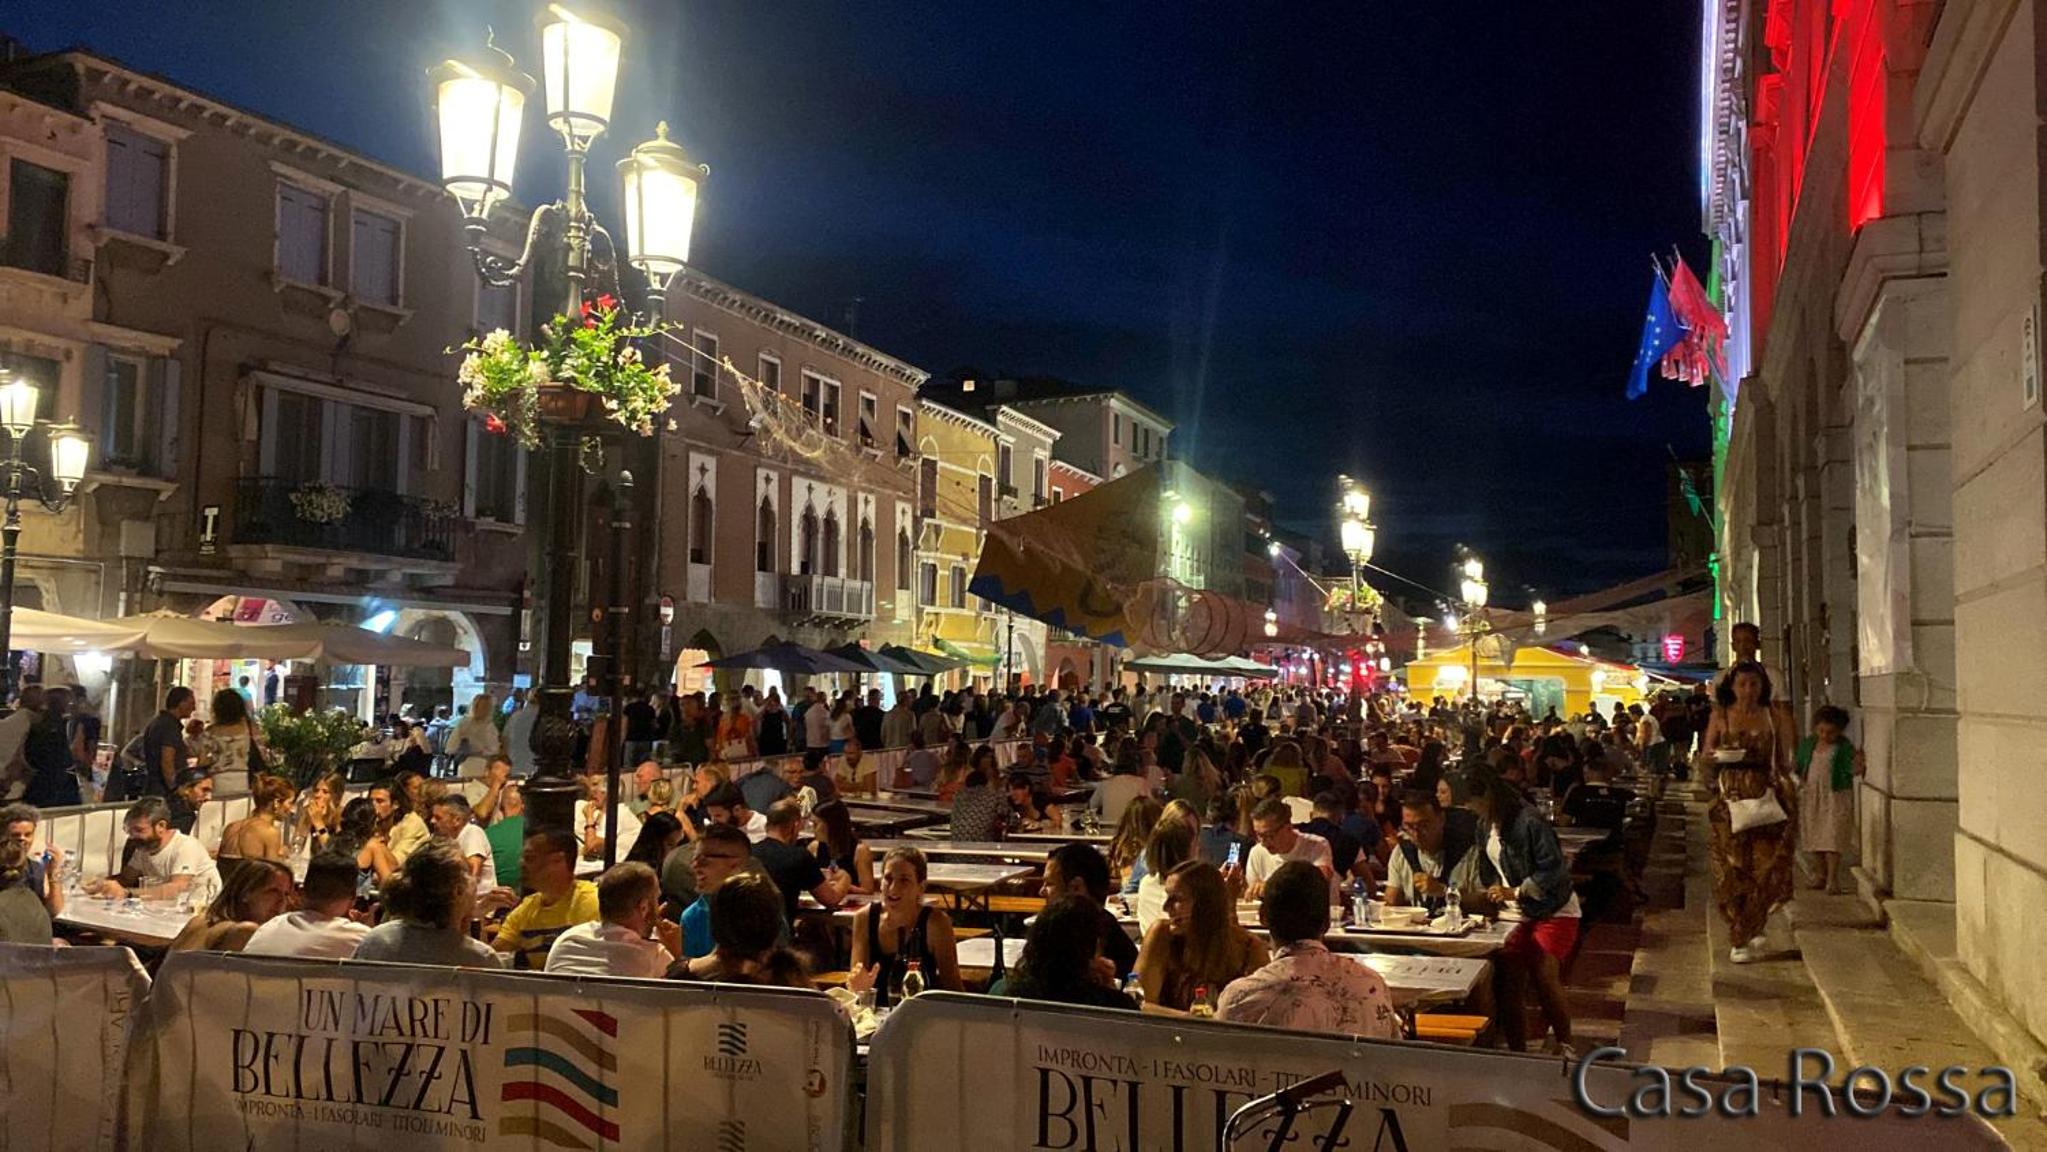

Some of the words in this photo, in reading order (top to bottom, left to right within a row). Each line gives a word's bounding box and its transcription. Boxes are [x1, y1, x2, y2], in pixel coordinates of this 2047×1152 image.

[303, 989, 346, 1032] UN
[352, 992, 450, 1041] MARE
[460, 1001, 495, 1045] DI
[230, 1028, 484, 1121] BELLEZZA
[1038, 1044, 1139, 1077] IMPRONTA
[1162, 1060, 1257, 1088] FASOLARI
[1342, 1083, 1432, 1107] MINORI
